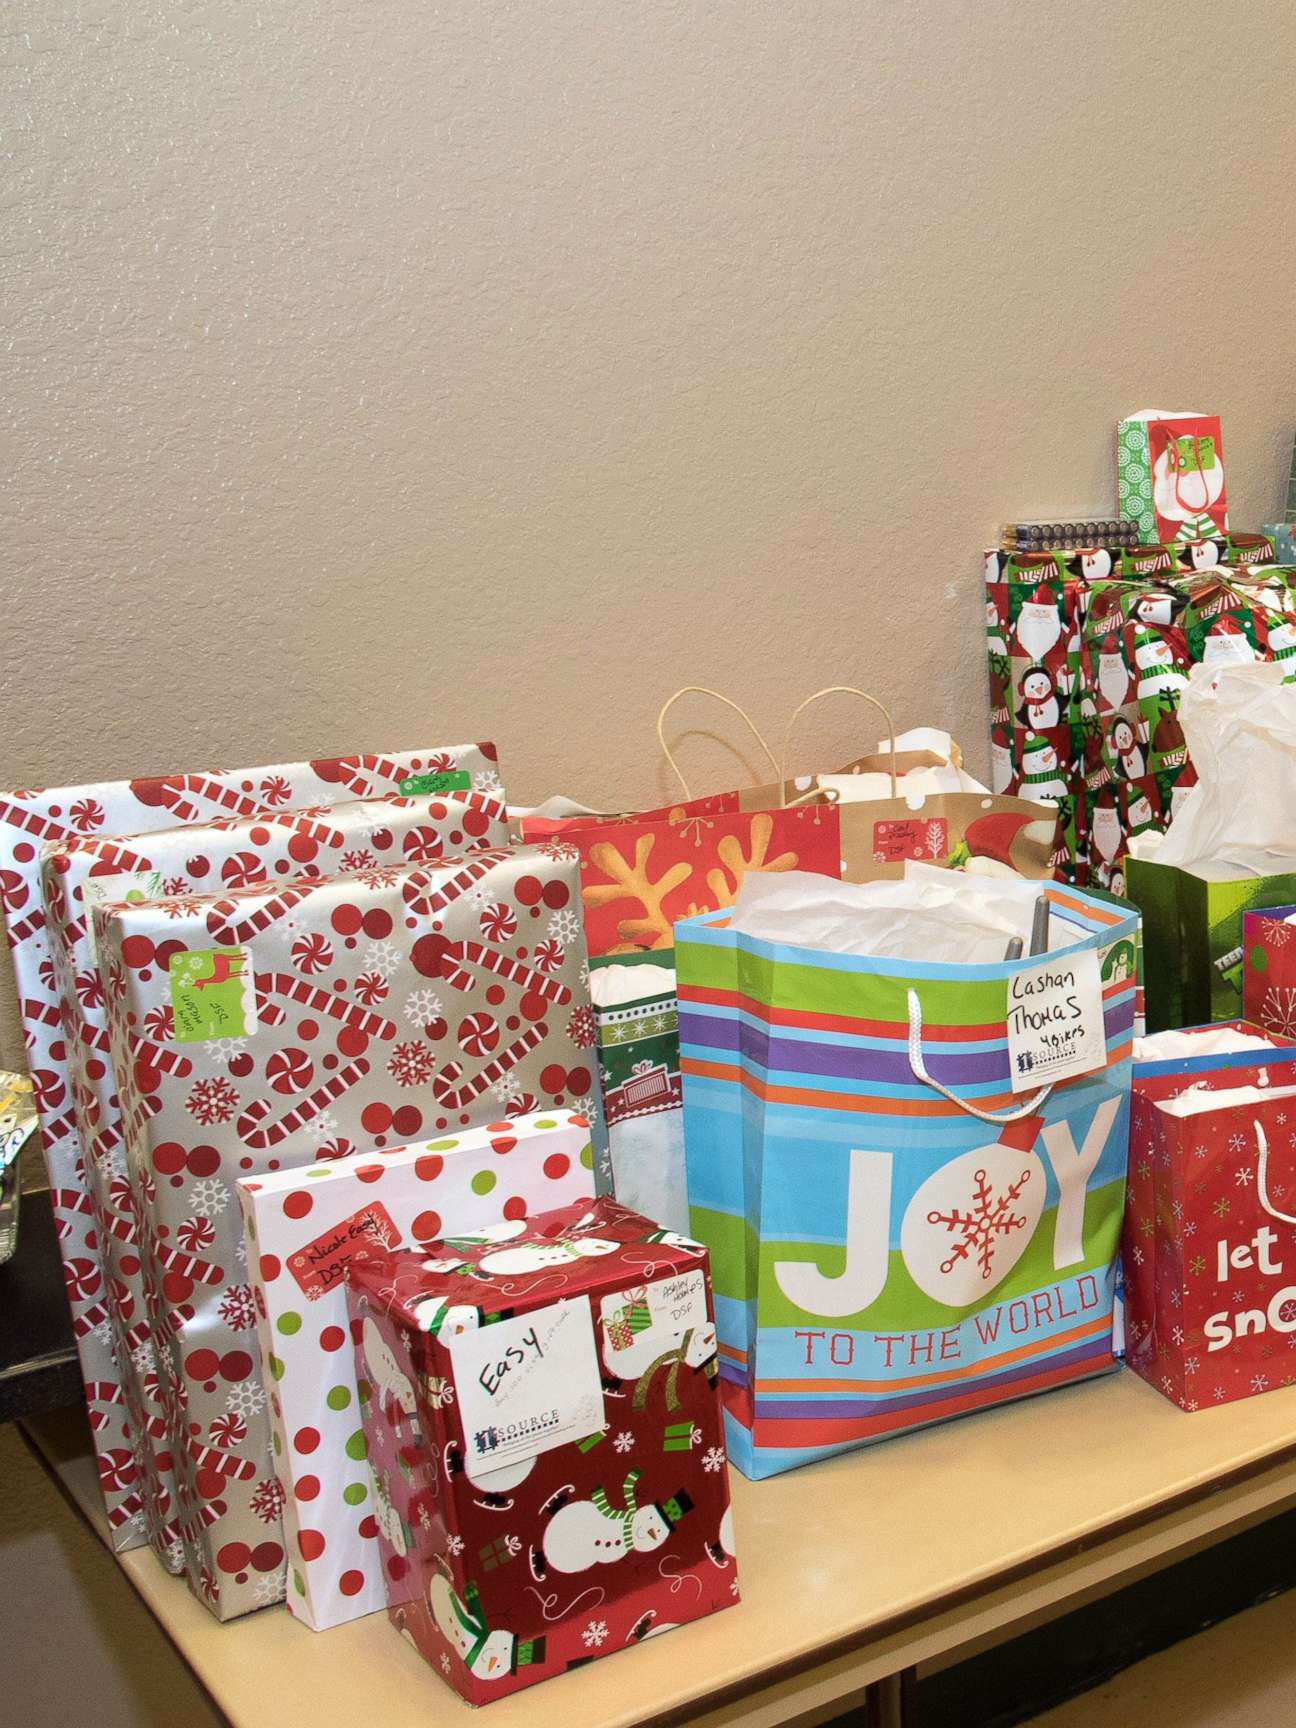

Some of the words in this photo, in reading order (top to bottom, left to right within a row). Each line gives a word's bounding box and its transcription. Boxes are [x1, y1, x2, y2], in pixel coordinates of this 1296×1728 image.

[774, 1094, 1122, 1318] JOY
[1217, 1225, 1283, 1283] let
[795, 1330, 854, 1367] TO
[874, 1323, 961, 1368] THE
[975, 1274, 1099, 1345] WORLD
[478, 1327, 544, 1397] Easy
[497, 1409, 560, 1437] SOURCE
